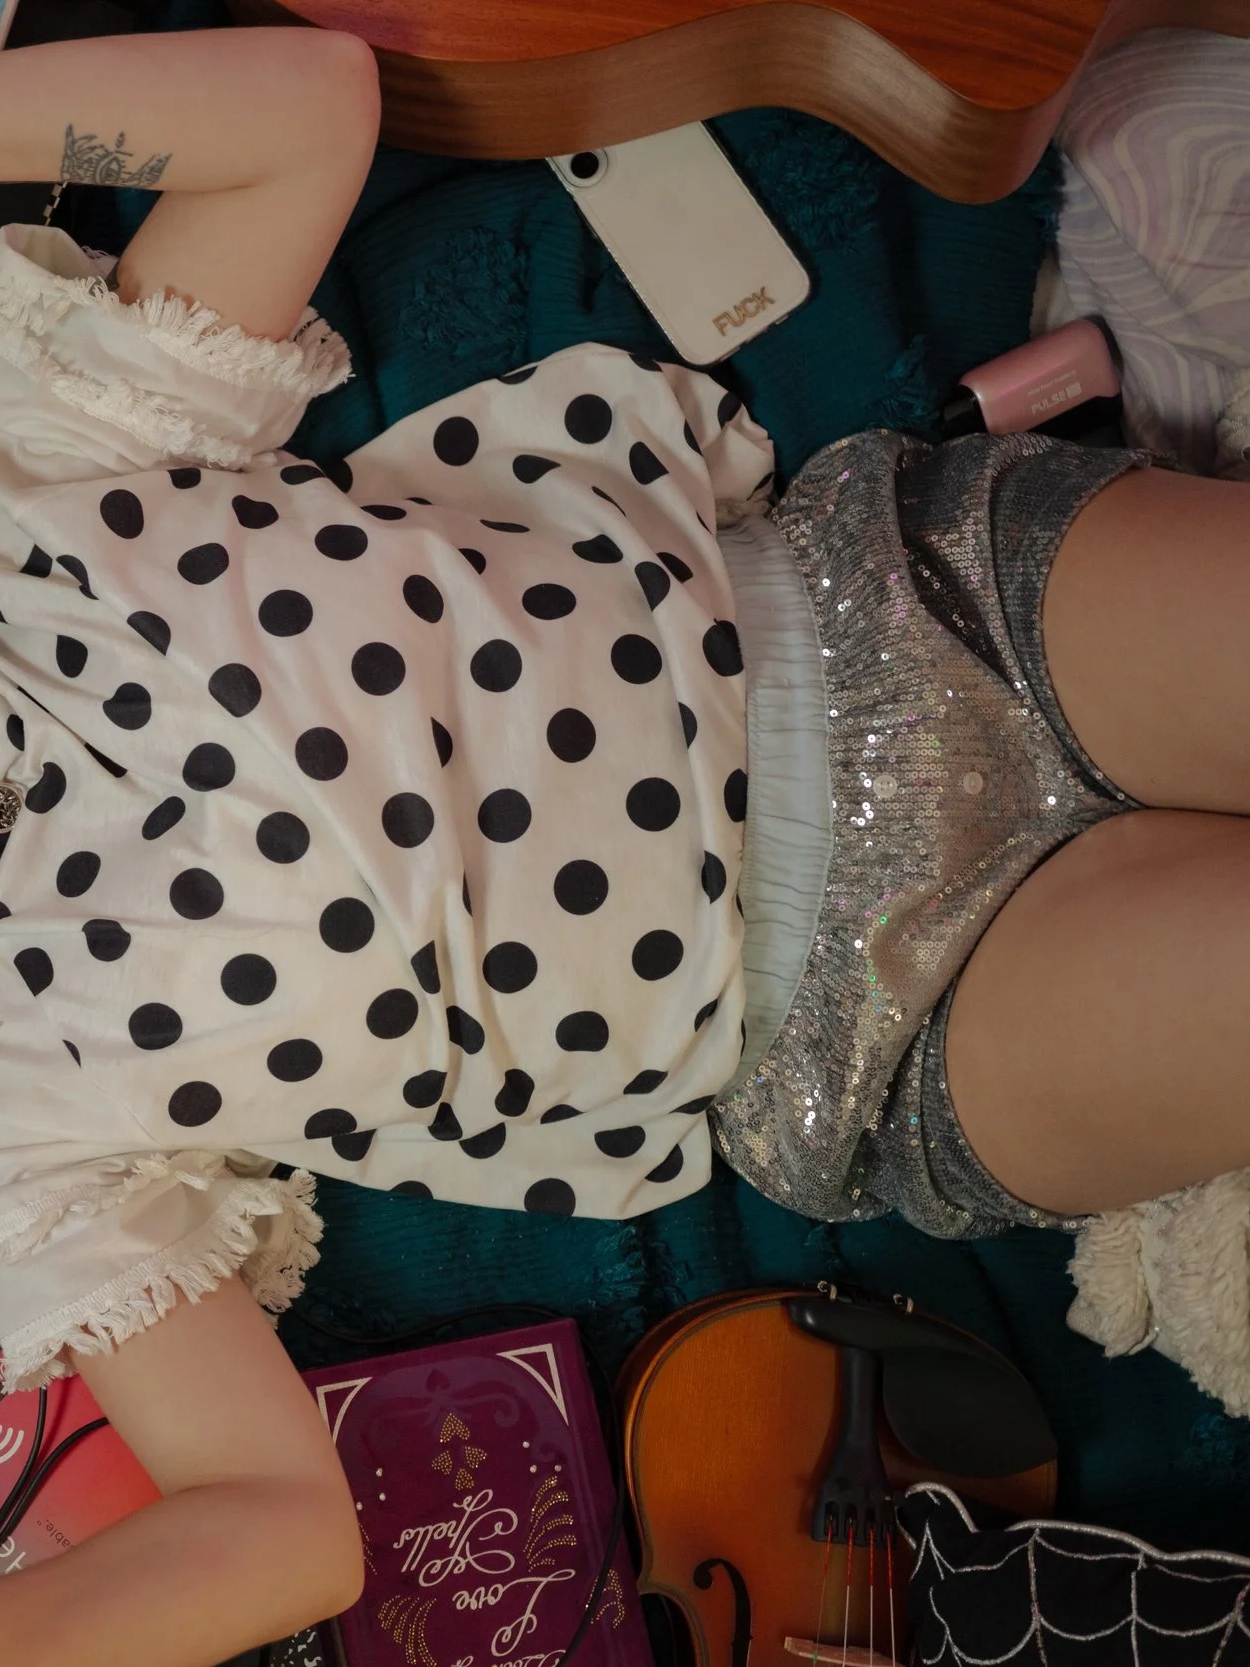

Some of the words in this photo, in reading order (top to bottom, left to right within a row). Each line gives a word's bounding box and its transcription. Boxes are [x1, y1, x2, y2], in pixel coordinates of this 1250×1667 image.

[712, 286, 775, 336] FUCK
[393, 1489, 518, 1587] Spells
[453, 1569, 576, 1657] Love
